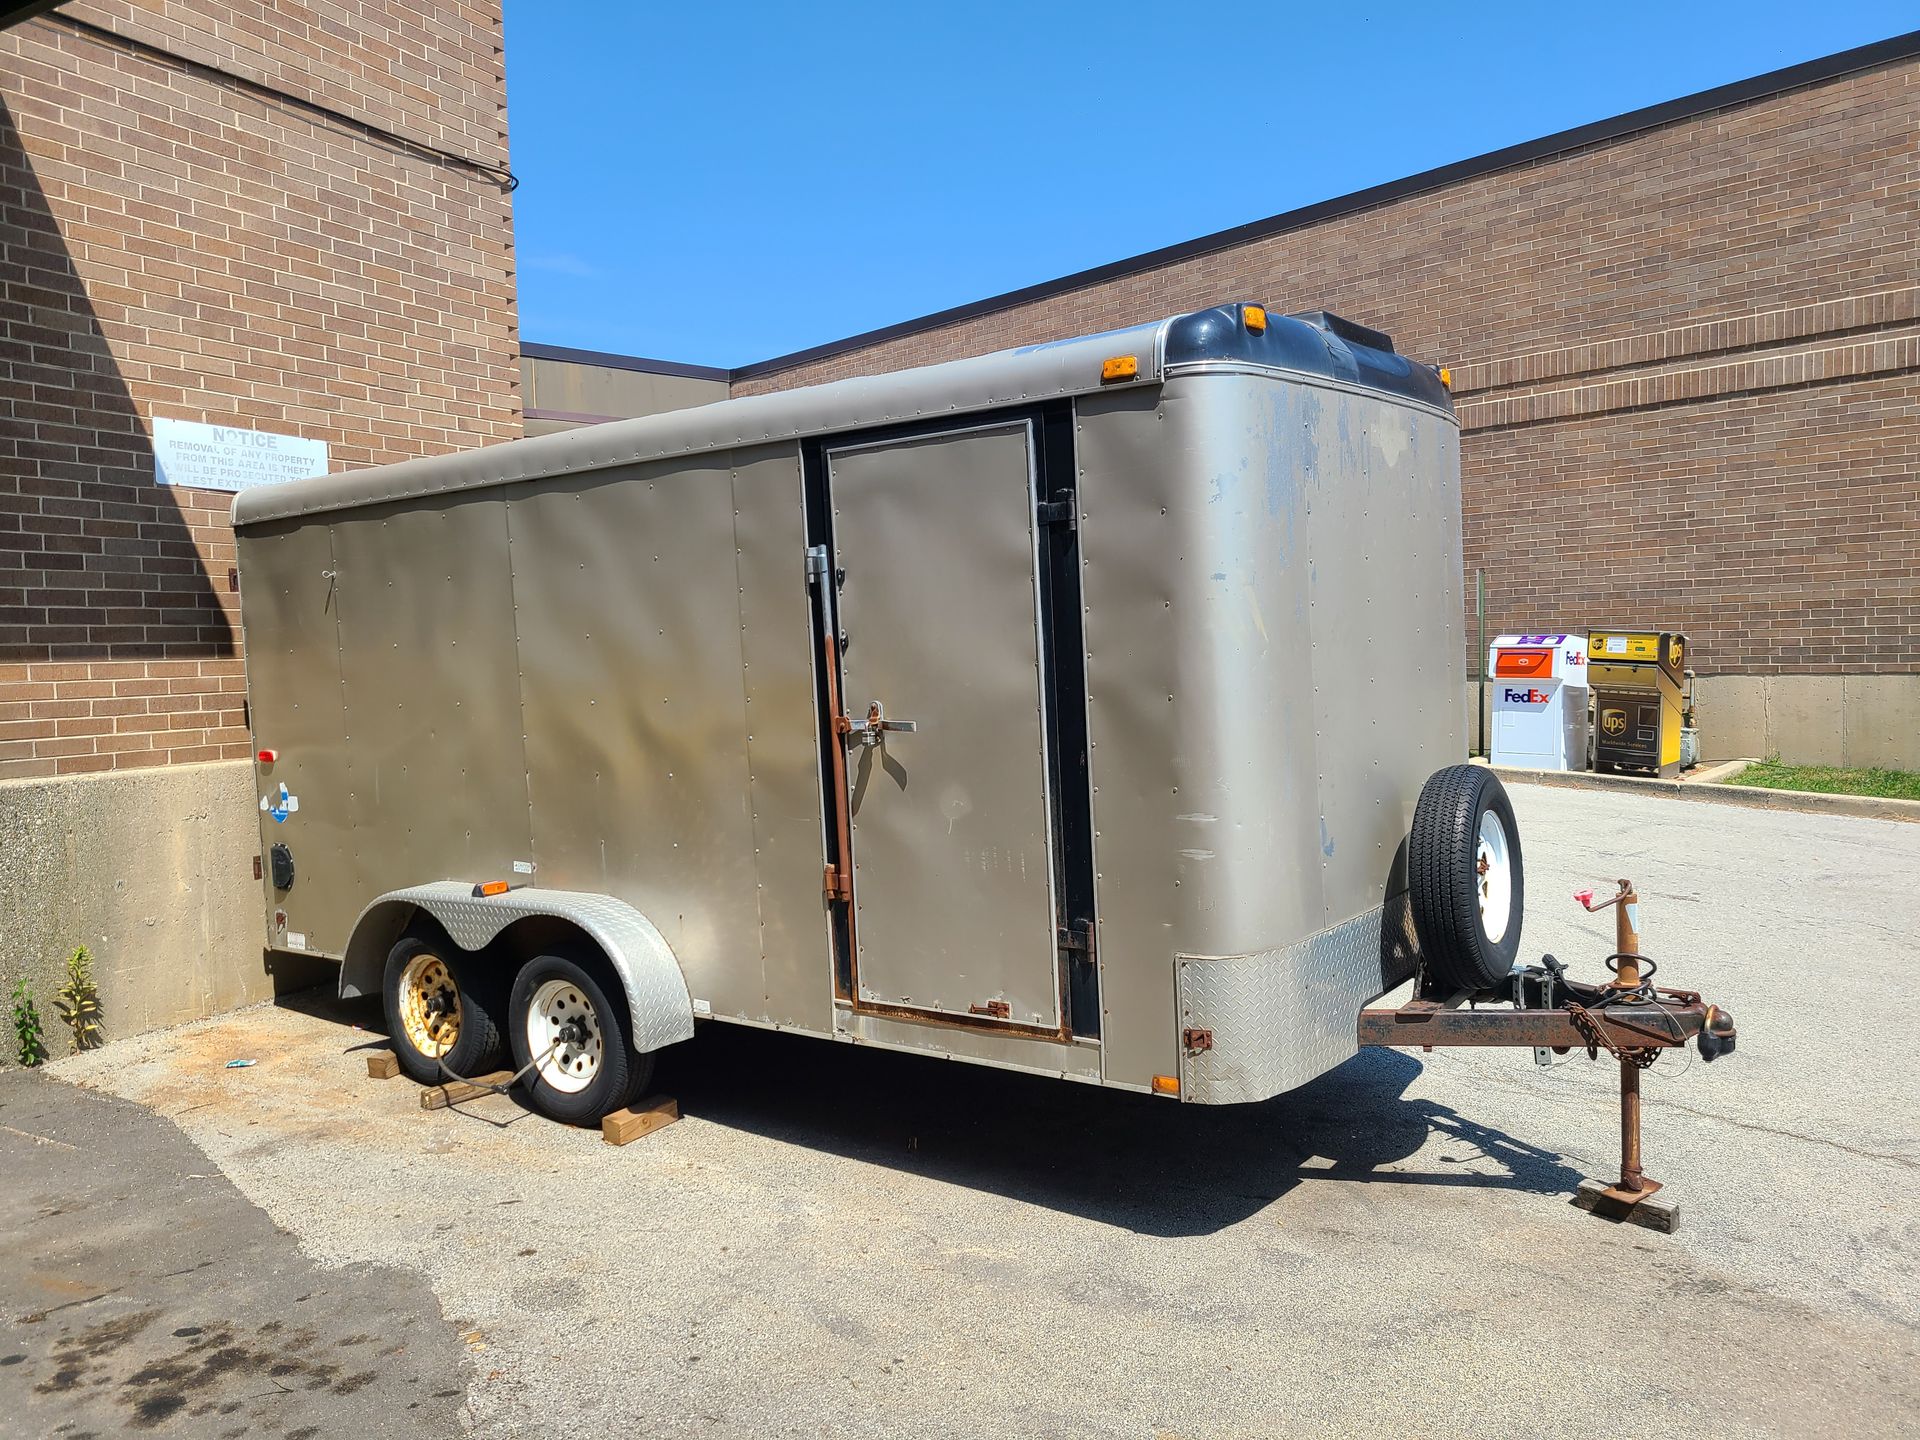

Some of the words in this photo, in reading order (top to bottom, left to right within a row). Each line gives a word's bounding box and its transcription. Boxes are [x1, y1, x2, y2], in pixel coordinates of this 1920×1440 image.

[212, 427, 278, 449] NOTICE
[169, 440, 220, 454] REMOVAL
[223, 447, 237, 456] OF
[241, 449, 262, 459] ANY
[265, 452, 315, 466] PROPERTY
[175, 462, 199, 473] WILL
[203, 466, 217, 475] BE
[220, 468, 287, 483] PROSECUTED
[176, 452, 207, 463] FROM
[210, 456, 234, 467] THIS
[238, 459, 265, 471] AREA
[268, 463, 278, 472] IS
[282, 465, 311, 476] THEFT
[1566, 650, 1586, 666] FedEx
[1504, 688, 1549, 703] FedEx
[1604, 717, 1624, 732] ups
